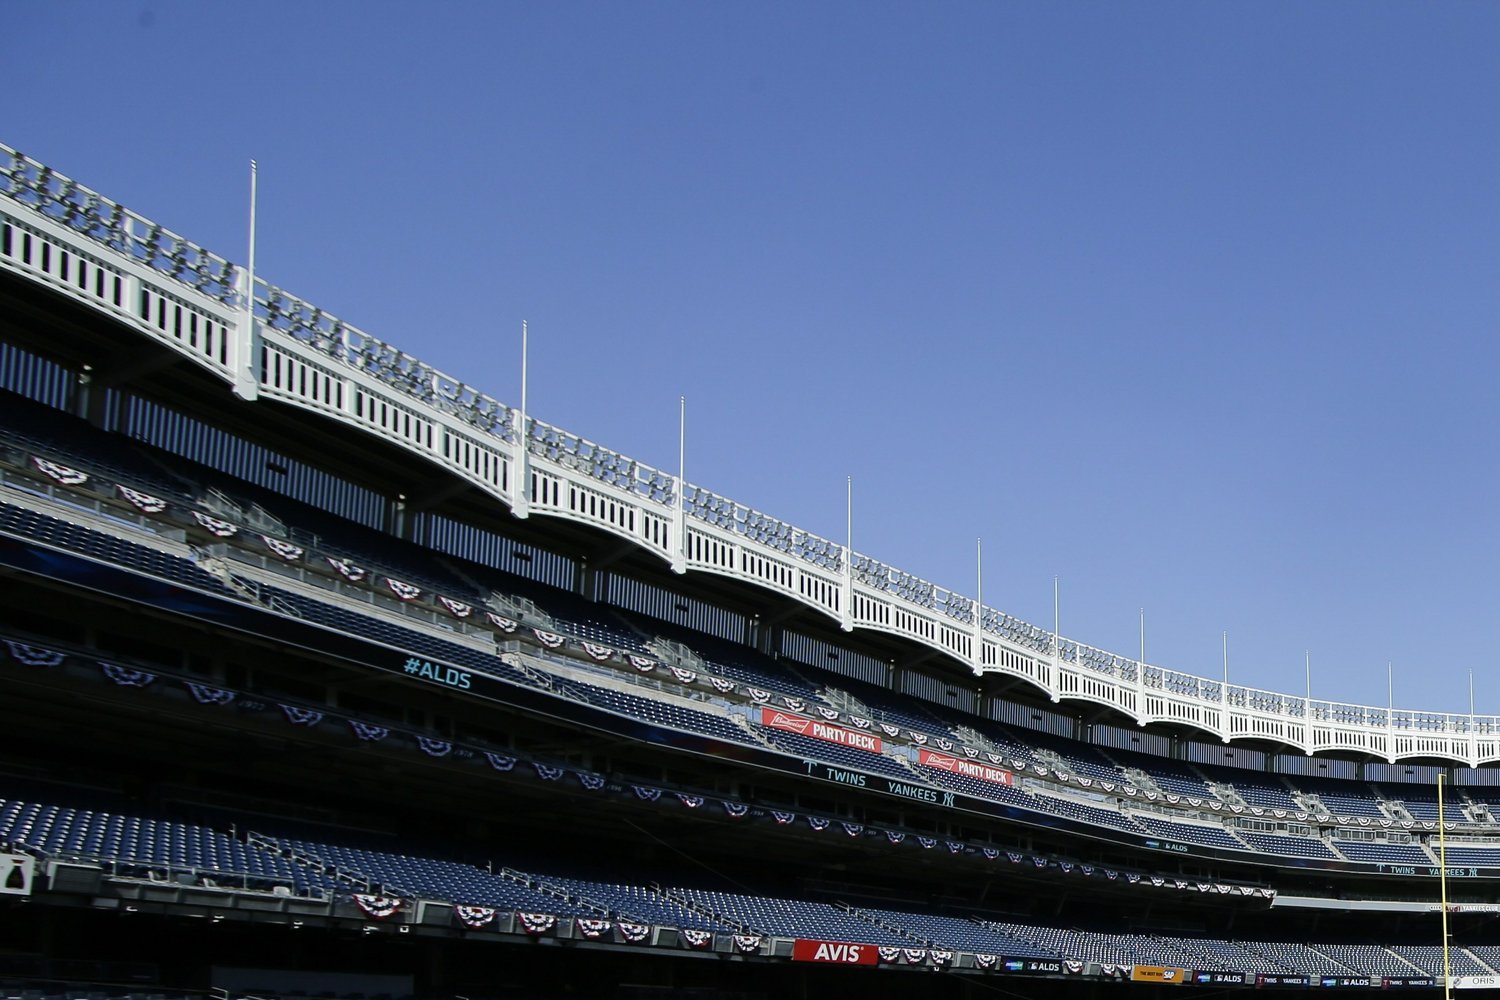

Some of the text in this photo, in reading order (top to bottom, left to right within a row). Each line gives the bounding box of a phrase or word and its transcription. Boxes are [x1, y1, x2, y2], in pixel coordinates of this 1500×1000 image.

[404, 657, 471, 689] #ALDS
[813, 723, 847, 742] PARTY
[848, 733, 875, 750] DECK
[958, 762, 984, 777] PARTY
[986, 768, 1007, 783] DECK
[827, 768, 866, 786] TWINS
[888, 781, 937, 802] YANKEES
[1390, 867, 1415, 875] TWINS
[1429, 868, 1464, 877] YANKEES
[814, 943, 861, 962] AVIS
[1038, 963, 1059, 971] ALDS
[1163, 970, 1175, 979] SAP
[1223, 975, 1241, 983] ALDS
[1472, 977, 1495, 985] ORIS
